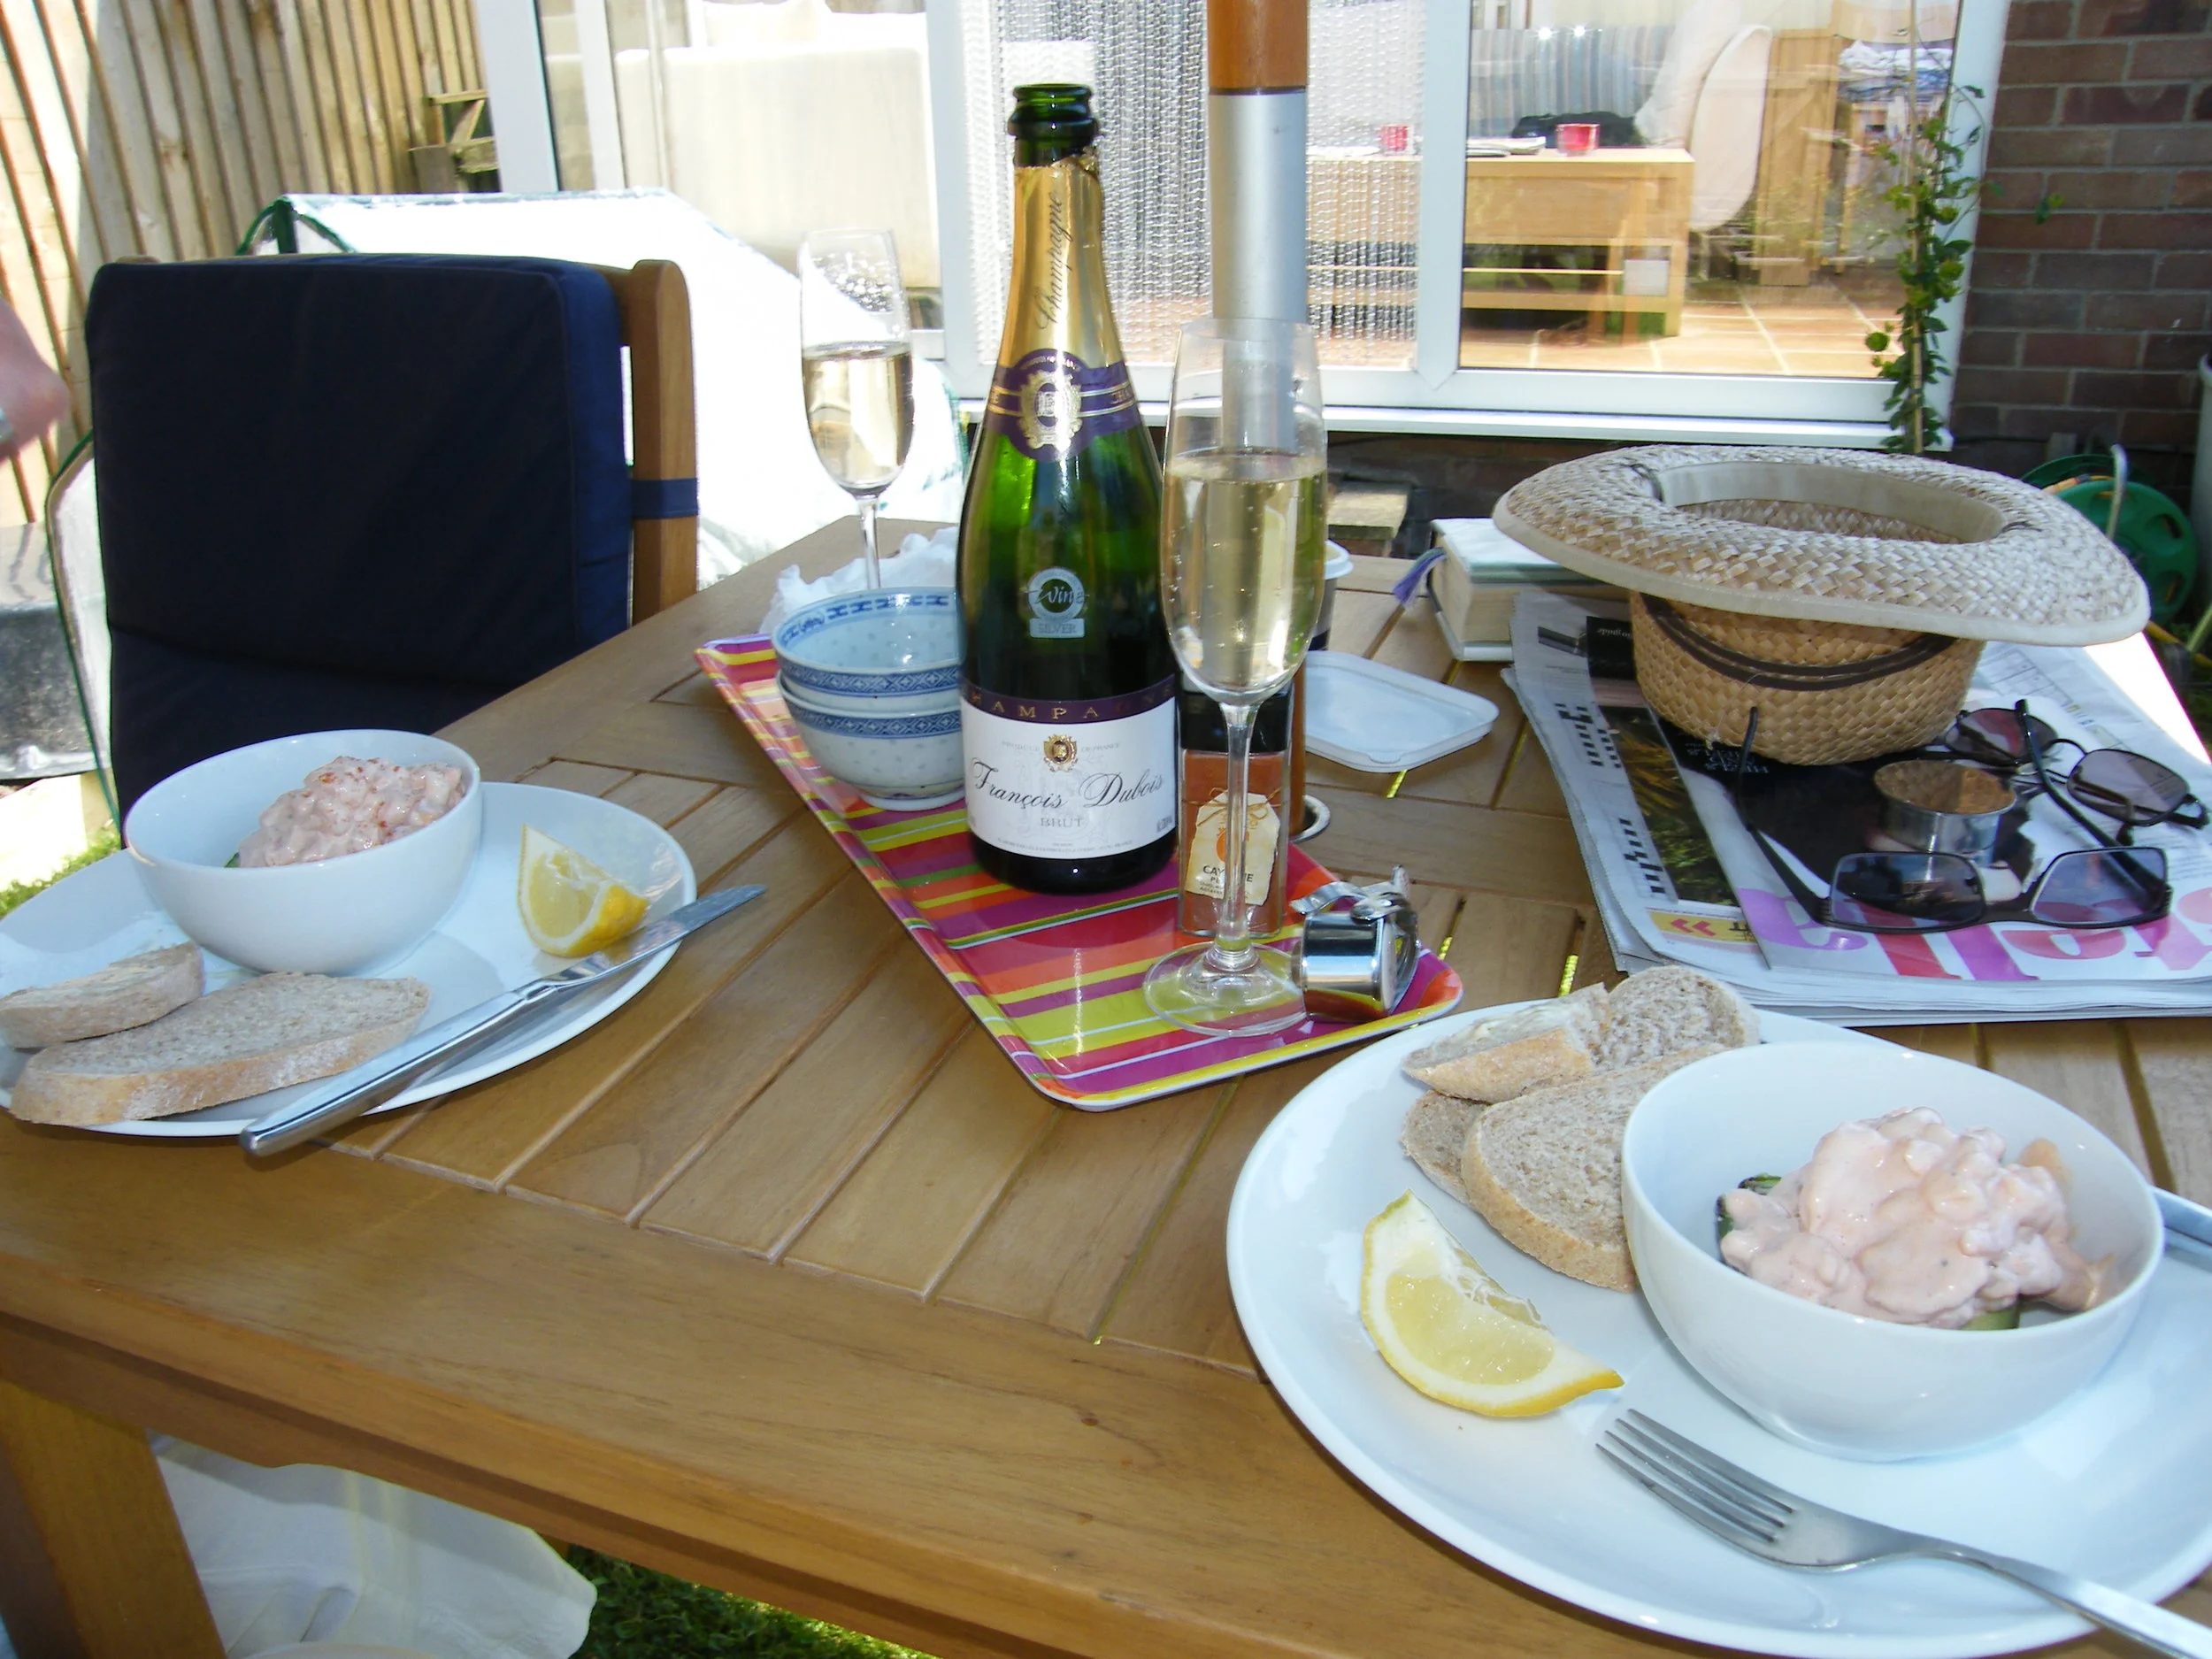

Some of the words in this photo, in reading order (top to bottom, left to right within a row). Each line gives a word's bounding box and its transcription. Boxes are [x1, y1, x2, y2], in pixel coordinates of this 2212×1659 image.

[1033, 191, 1073, 331] Champagne
[1038, 623, 1076, 634] SILVER
[970, 757, 1067, 810] François
[1079, 769, 1165, 809] Dubois
[1041, 818, 1084, 829] BRUT
